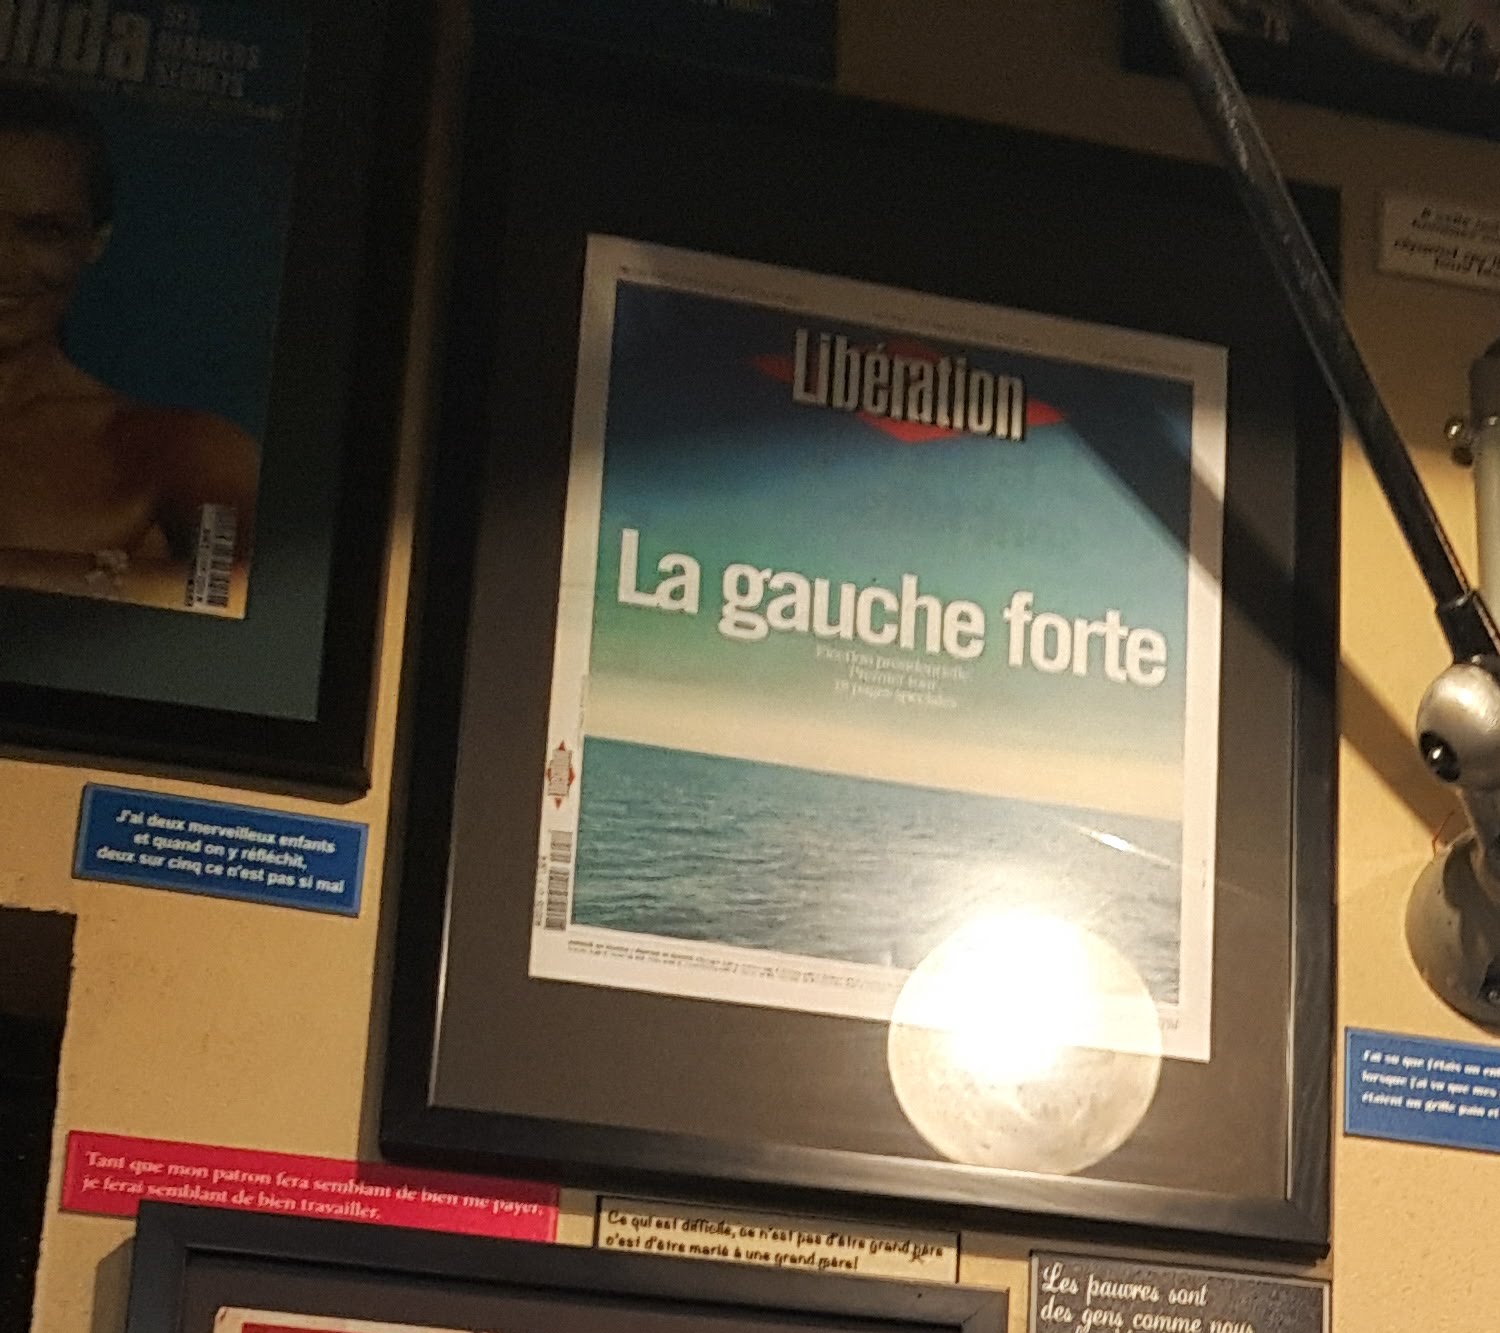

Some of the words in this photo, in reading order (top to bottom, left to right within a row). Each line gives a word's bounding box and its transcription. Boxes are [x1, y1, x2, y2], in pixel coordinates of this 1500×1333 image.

[792, 328, 1027, 442] Libération
[618, 528, 701, 615] La
[718, 563, 986, 660] gauche
[1003, 590, 1168, 687] forte
[116, 809, 143, 824] J'ai
[147, 812, 185, 831] deux
[188, 821, 276, 845] merveilleux
[279, 834, 336, 854] enfants
[134, 832, 150, 846] et
[153, 834, 201, 854] quand
[204, 844, 225, 856] on
[228, 847, 238, 861] y
[96, 846, 136, 862] deux
[139, 854, 164, 868] sur
[168, 854, 202, 875] cinq
[205, 862, 224, 876] ce
[227, 864, 264, 882] n'est
[268, 872, 296, 888] pas
[299, 876, 313, 889] si
[316, 878, 345, 894] mal
[86, 1150, 126, 1169] Tant
[129, 1159, 164, 1176] que
[167, 1163, 209, 1179] mon
[213, 1167, 273, 1186] patron
[275, 1171, 309, 1190] fera
[313, 1175, 392, 1200] semblant
[396, 1182, 417, 1201] de
[421, 1185, 458, 1207] bien
[463, 1195, 490, 1210] me
[1041, 1261, 1078, 1294] Les
[1087, 1273, 1159, 1305] pauvres
[1168, 1283, 1208, 1307] sont
[1040, 1296, 1073, 1323] des
[1082, 1306, 1124, 1333] gens
[1132, 1312, 1201, 1333] comme
